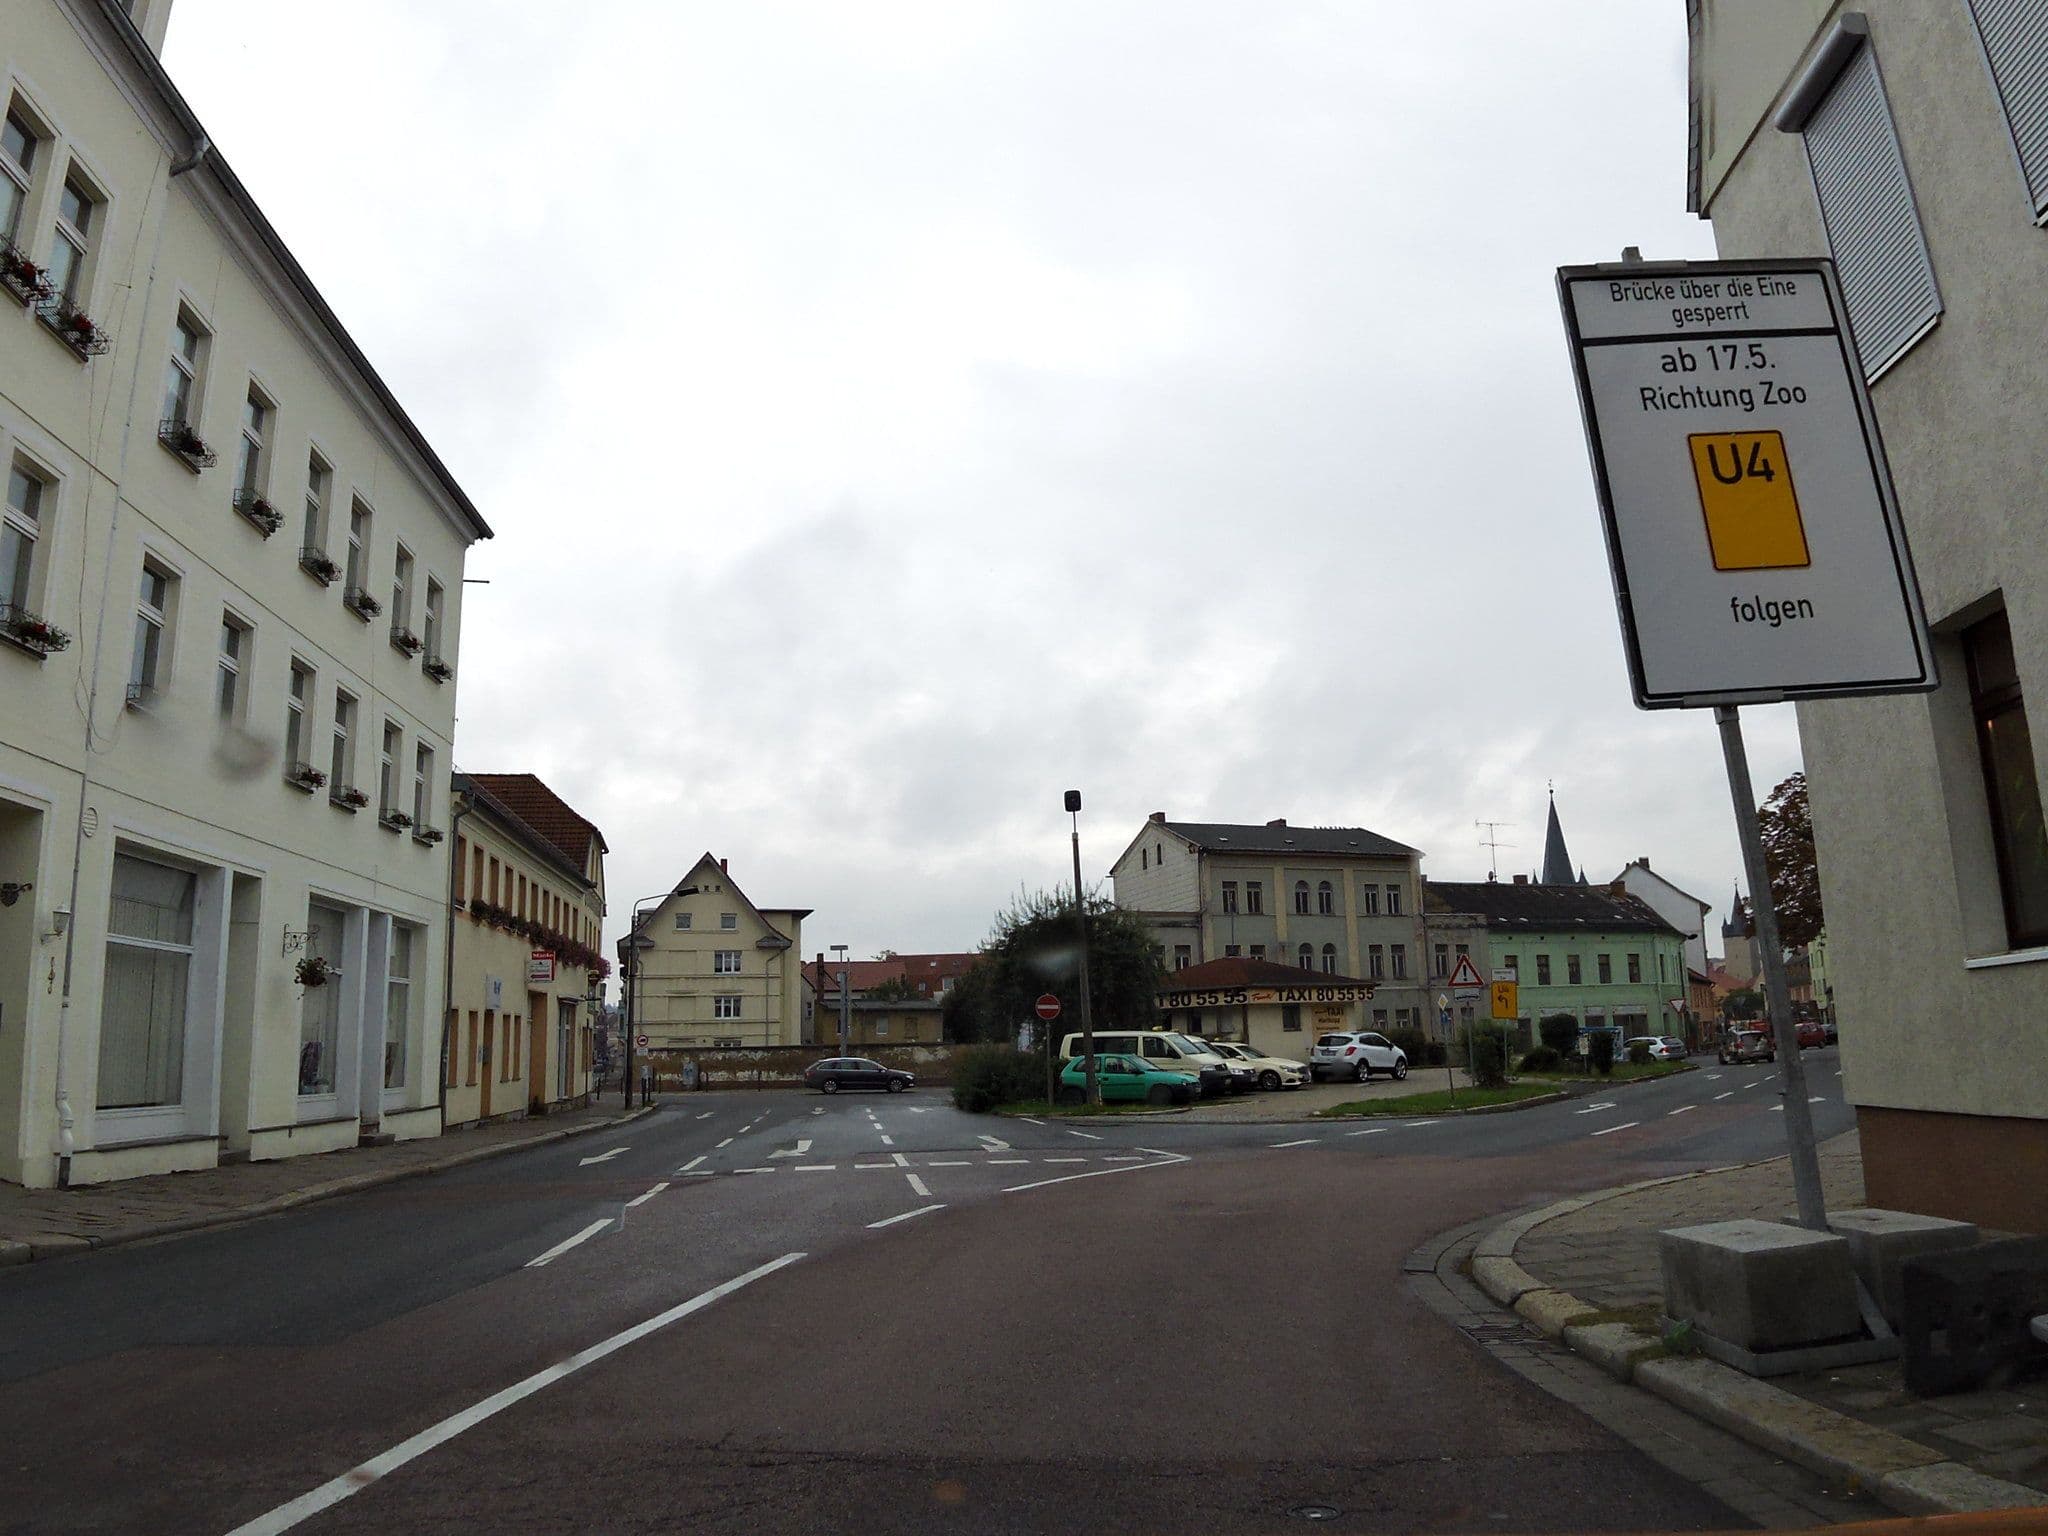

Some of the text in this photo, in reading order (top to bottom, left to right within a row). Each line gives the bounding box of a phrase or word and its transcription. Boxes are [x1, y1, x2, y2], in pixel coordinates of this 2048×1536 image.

[1610, 275, 1797, 302] Brücke über die Eine
[1672, 302, 1750, 327] gesperrt
[1660, 344, 1776, 374] ab 17.5.
[1640, 382, 1807, 413] Richtung Zoo
[1707, 442, 1775, 485] U4
[1731, 595, 1814, 627] folgen
[1169, 991, 1191, 1007] 80
[1196, 990, 1219, 1005] 55
[1223, 988, 1248, 1004] 55
[1276, 987, 1312, 1001] TAXI
[1316, 987, 1334, 1001] 80
[1337, 988, 1355, 1000] 55
[1357, 987, 1375, 1000] 55
